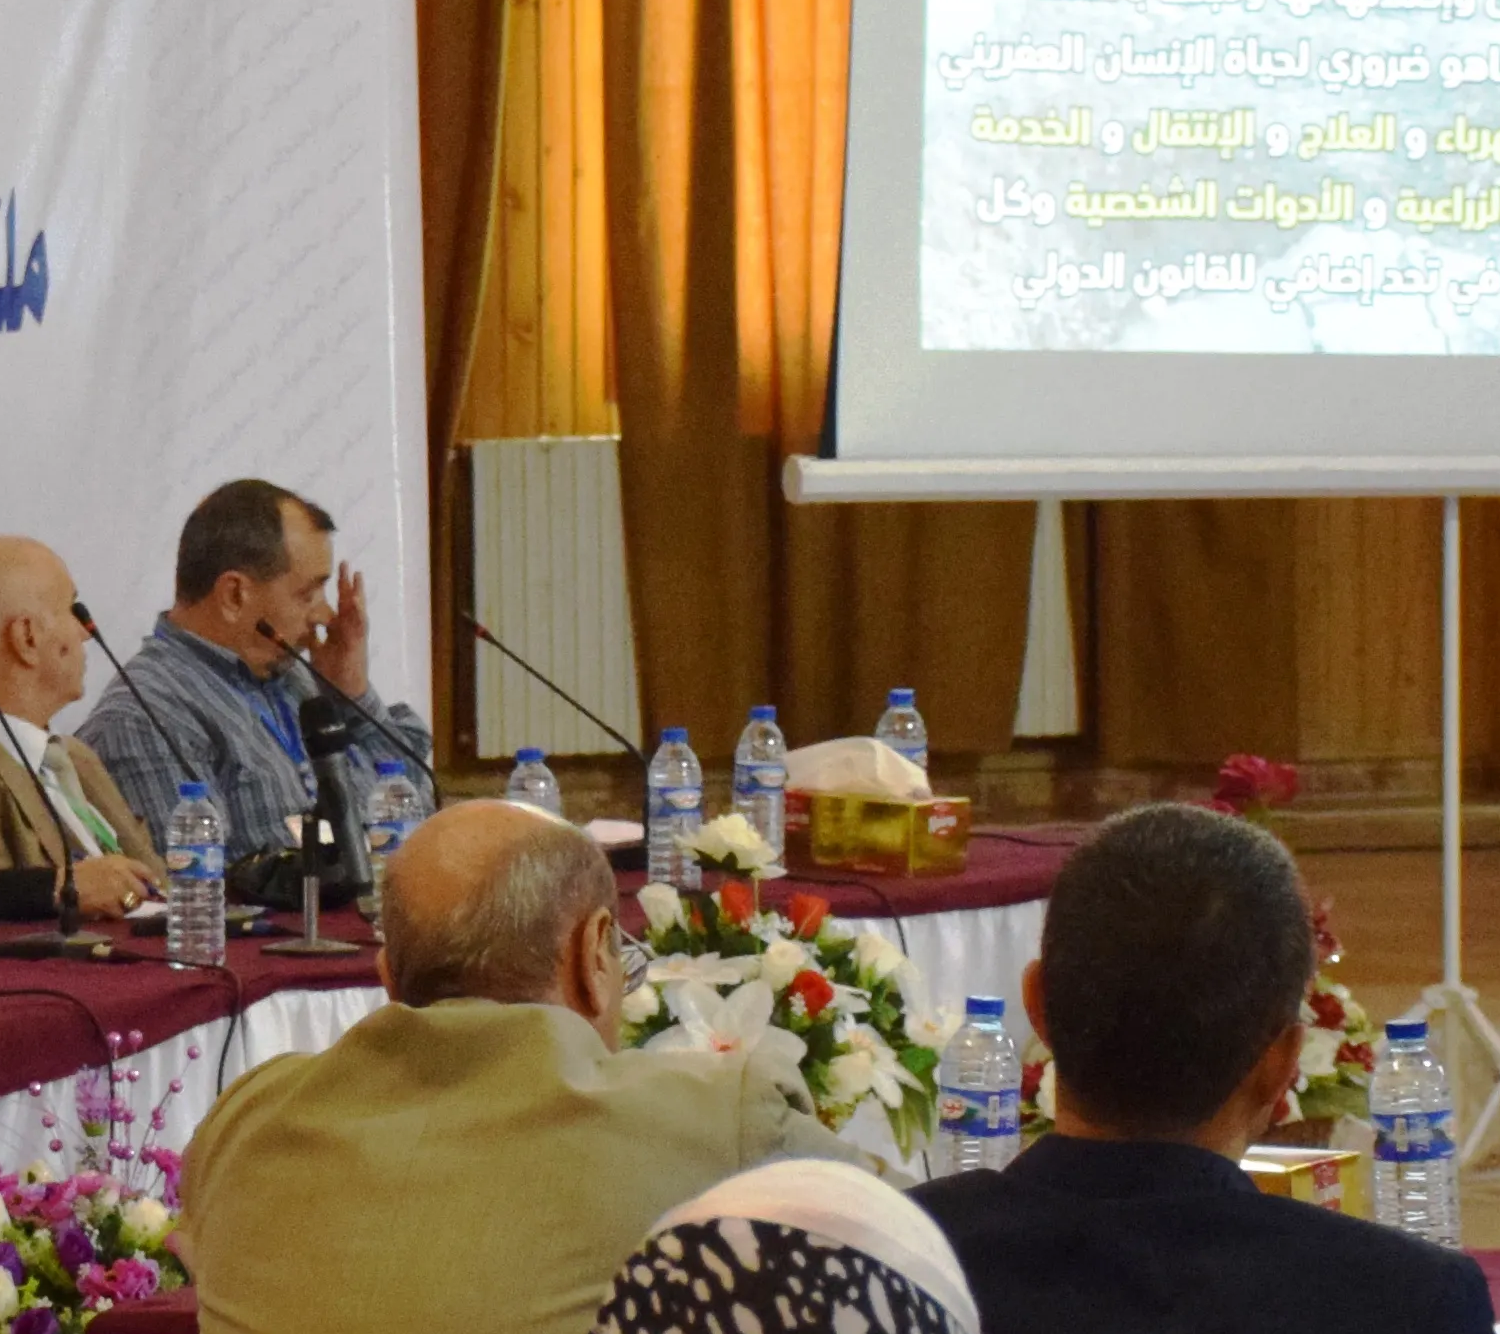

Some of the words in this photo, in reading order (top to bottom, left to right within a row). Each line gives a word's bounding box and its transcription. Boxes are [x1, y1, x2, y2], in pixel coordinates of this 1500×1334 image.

[939, 32, 1085, 90] العفريني
[1093, 35, 1215, 88] الإنسان
[1223, 37, 1310, 85] لحياة
[1318, 45, 1430, 93] ضروري
[971, 106, 1091, 146] الخدمة
[1102, 120, 1125, 154] و
[1132, 109, 1255, 158] الإنتقال
[1266, 122, 1290, 156] و
[1298, 112, 1395, 159] العلاج
[1404, 126, 1427, 159] و
[977, 177, 1055, 224] وكل
[1065, 174, 1218, 227] الشخصية
[1225, 177, 1353, 229] الأدوات
[1363, 197, 1388, 229] و
[1013, 251, 1124, 309] الدولي
[1133, 253, 1256, 296] للقانون
[1264, 253, 1374, 312] إضافي
[1448, 259, 1500, 315] في
